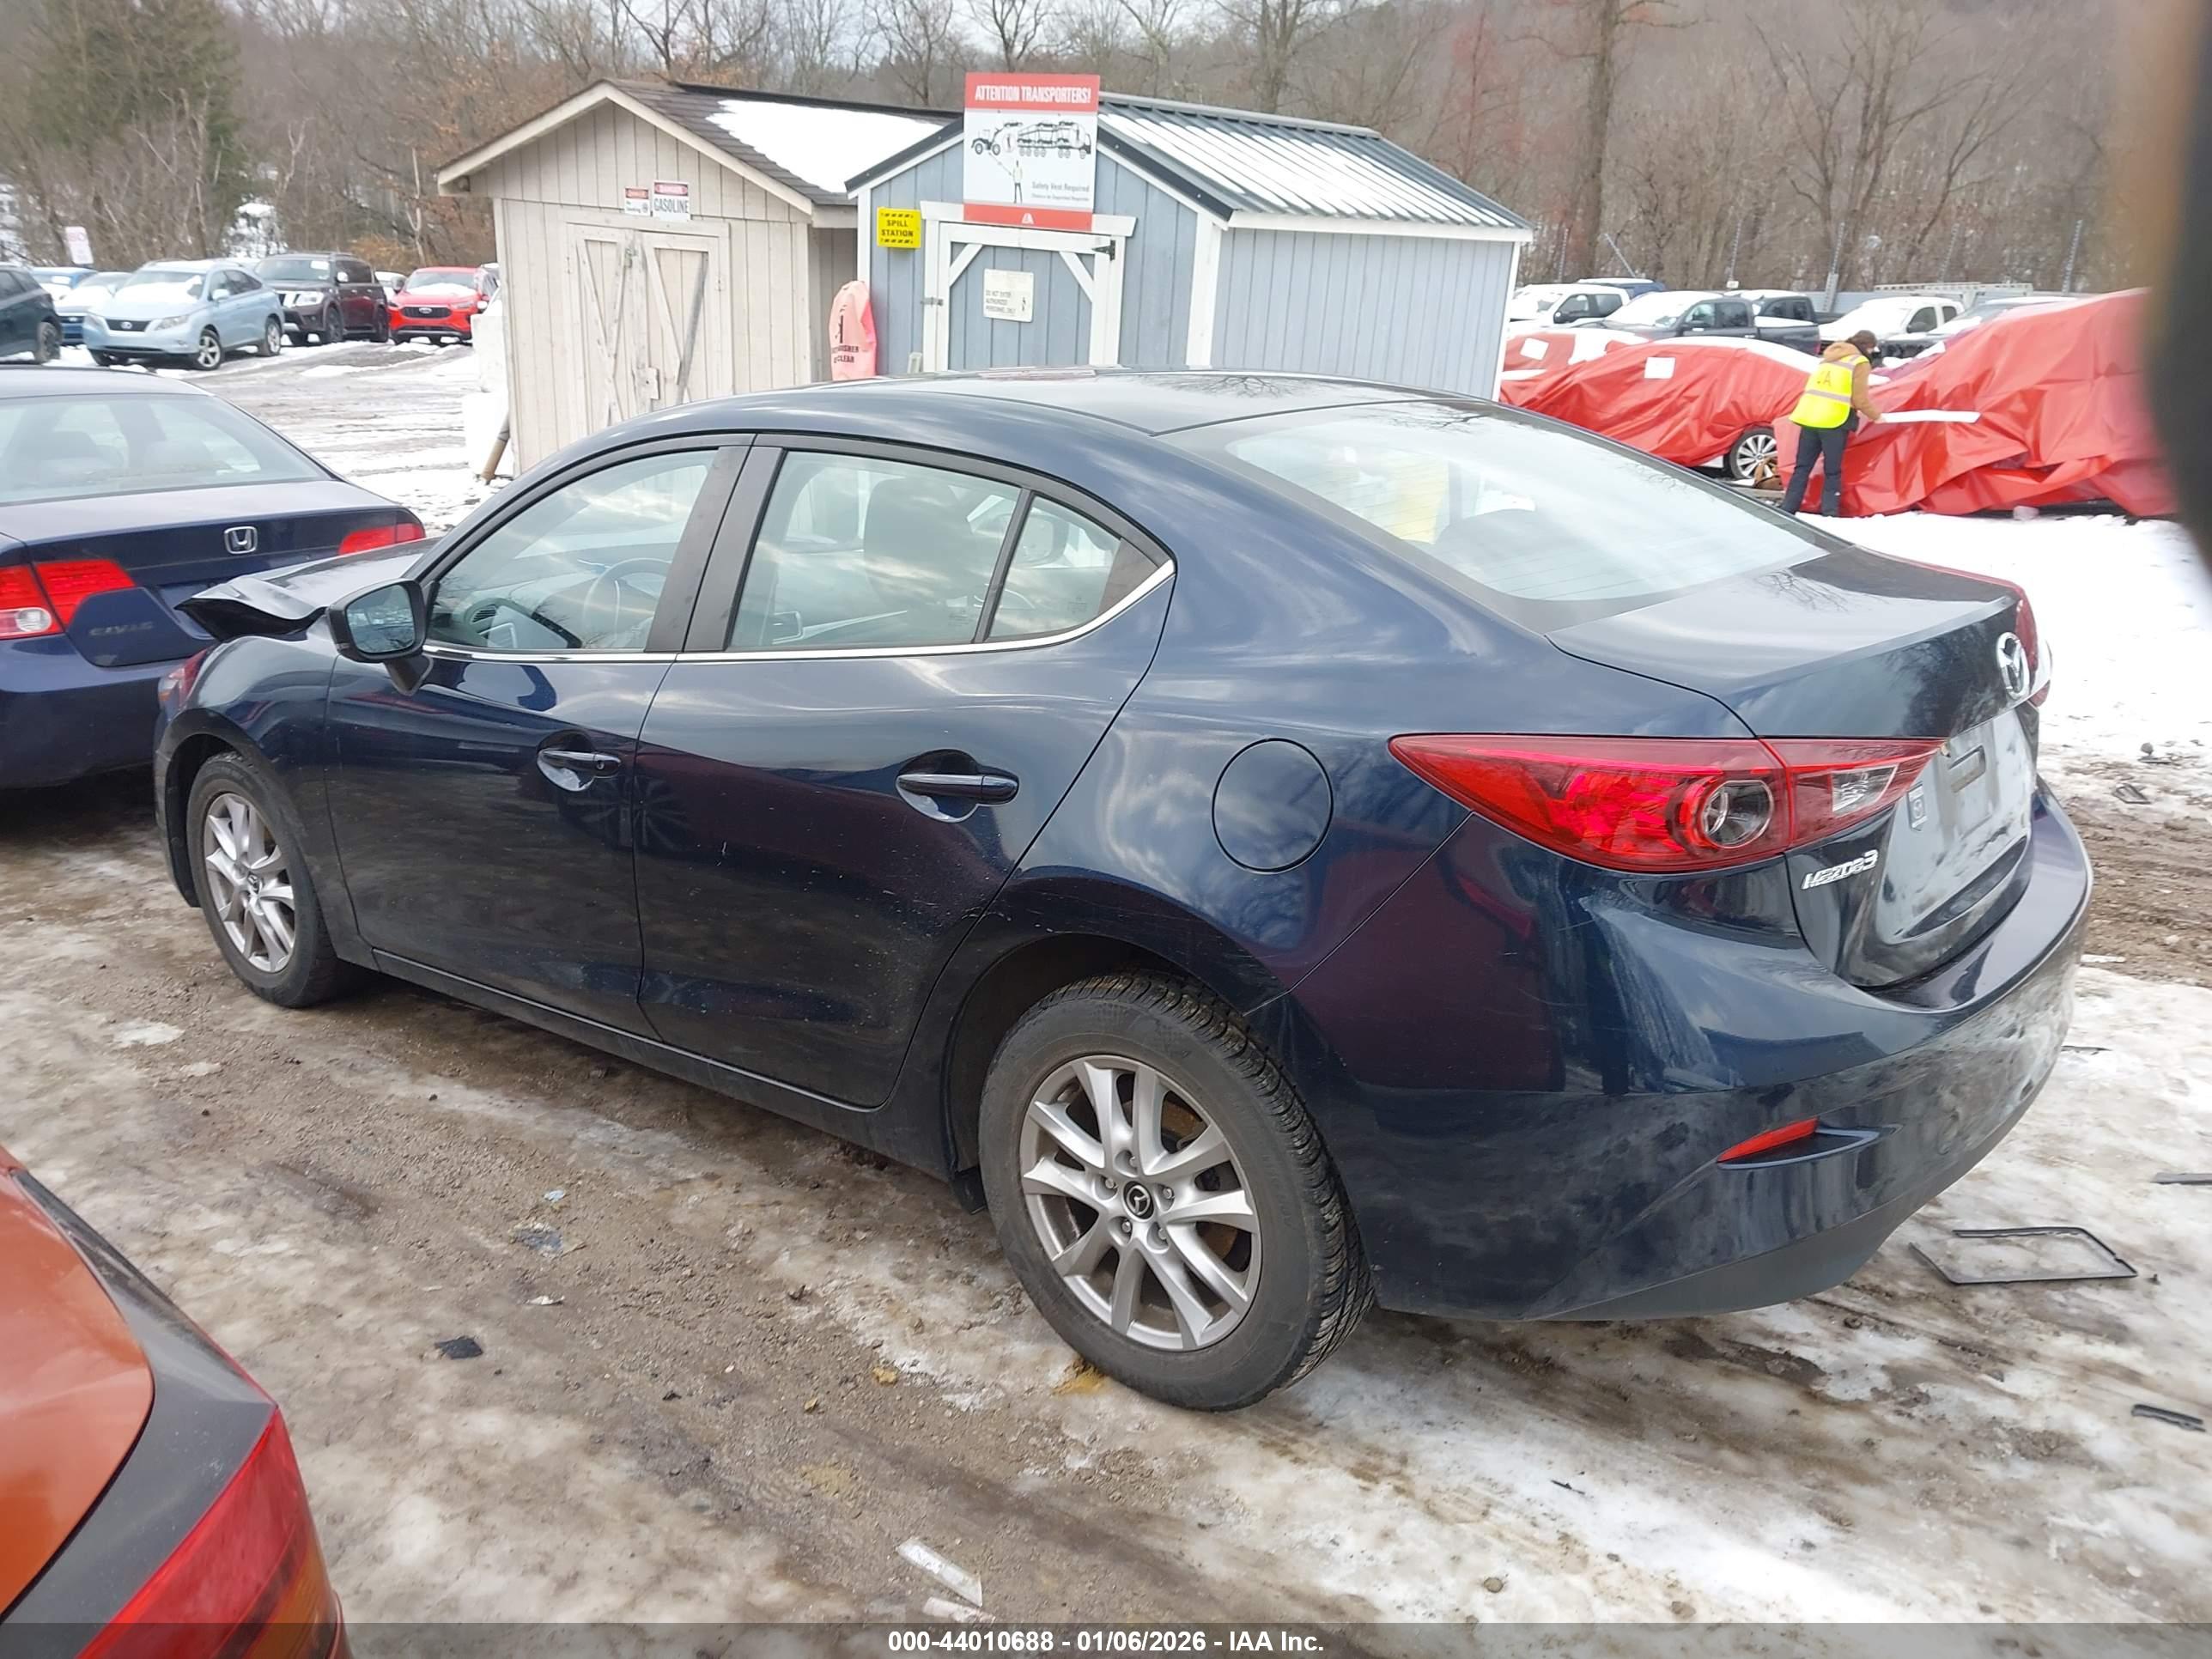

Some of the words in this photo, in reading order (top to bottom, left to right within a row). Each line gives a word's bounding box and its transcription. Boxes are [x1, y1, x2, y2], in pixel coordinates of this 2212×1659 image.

[975, 85, 1019, 101] ATTENTION
[1021, 86, 1091, 104] TRANSPORTERS!
[653, 198, 689, 214] GASOLINE
[881, 228, 914, 237] STATION
[89, 621, 154, 636] CIVIC
